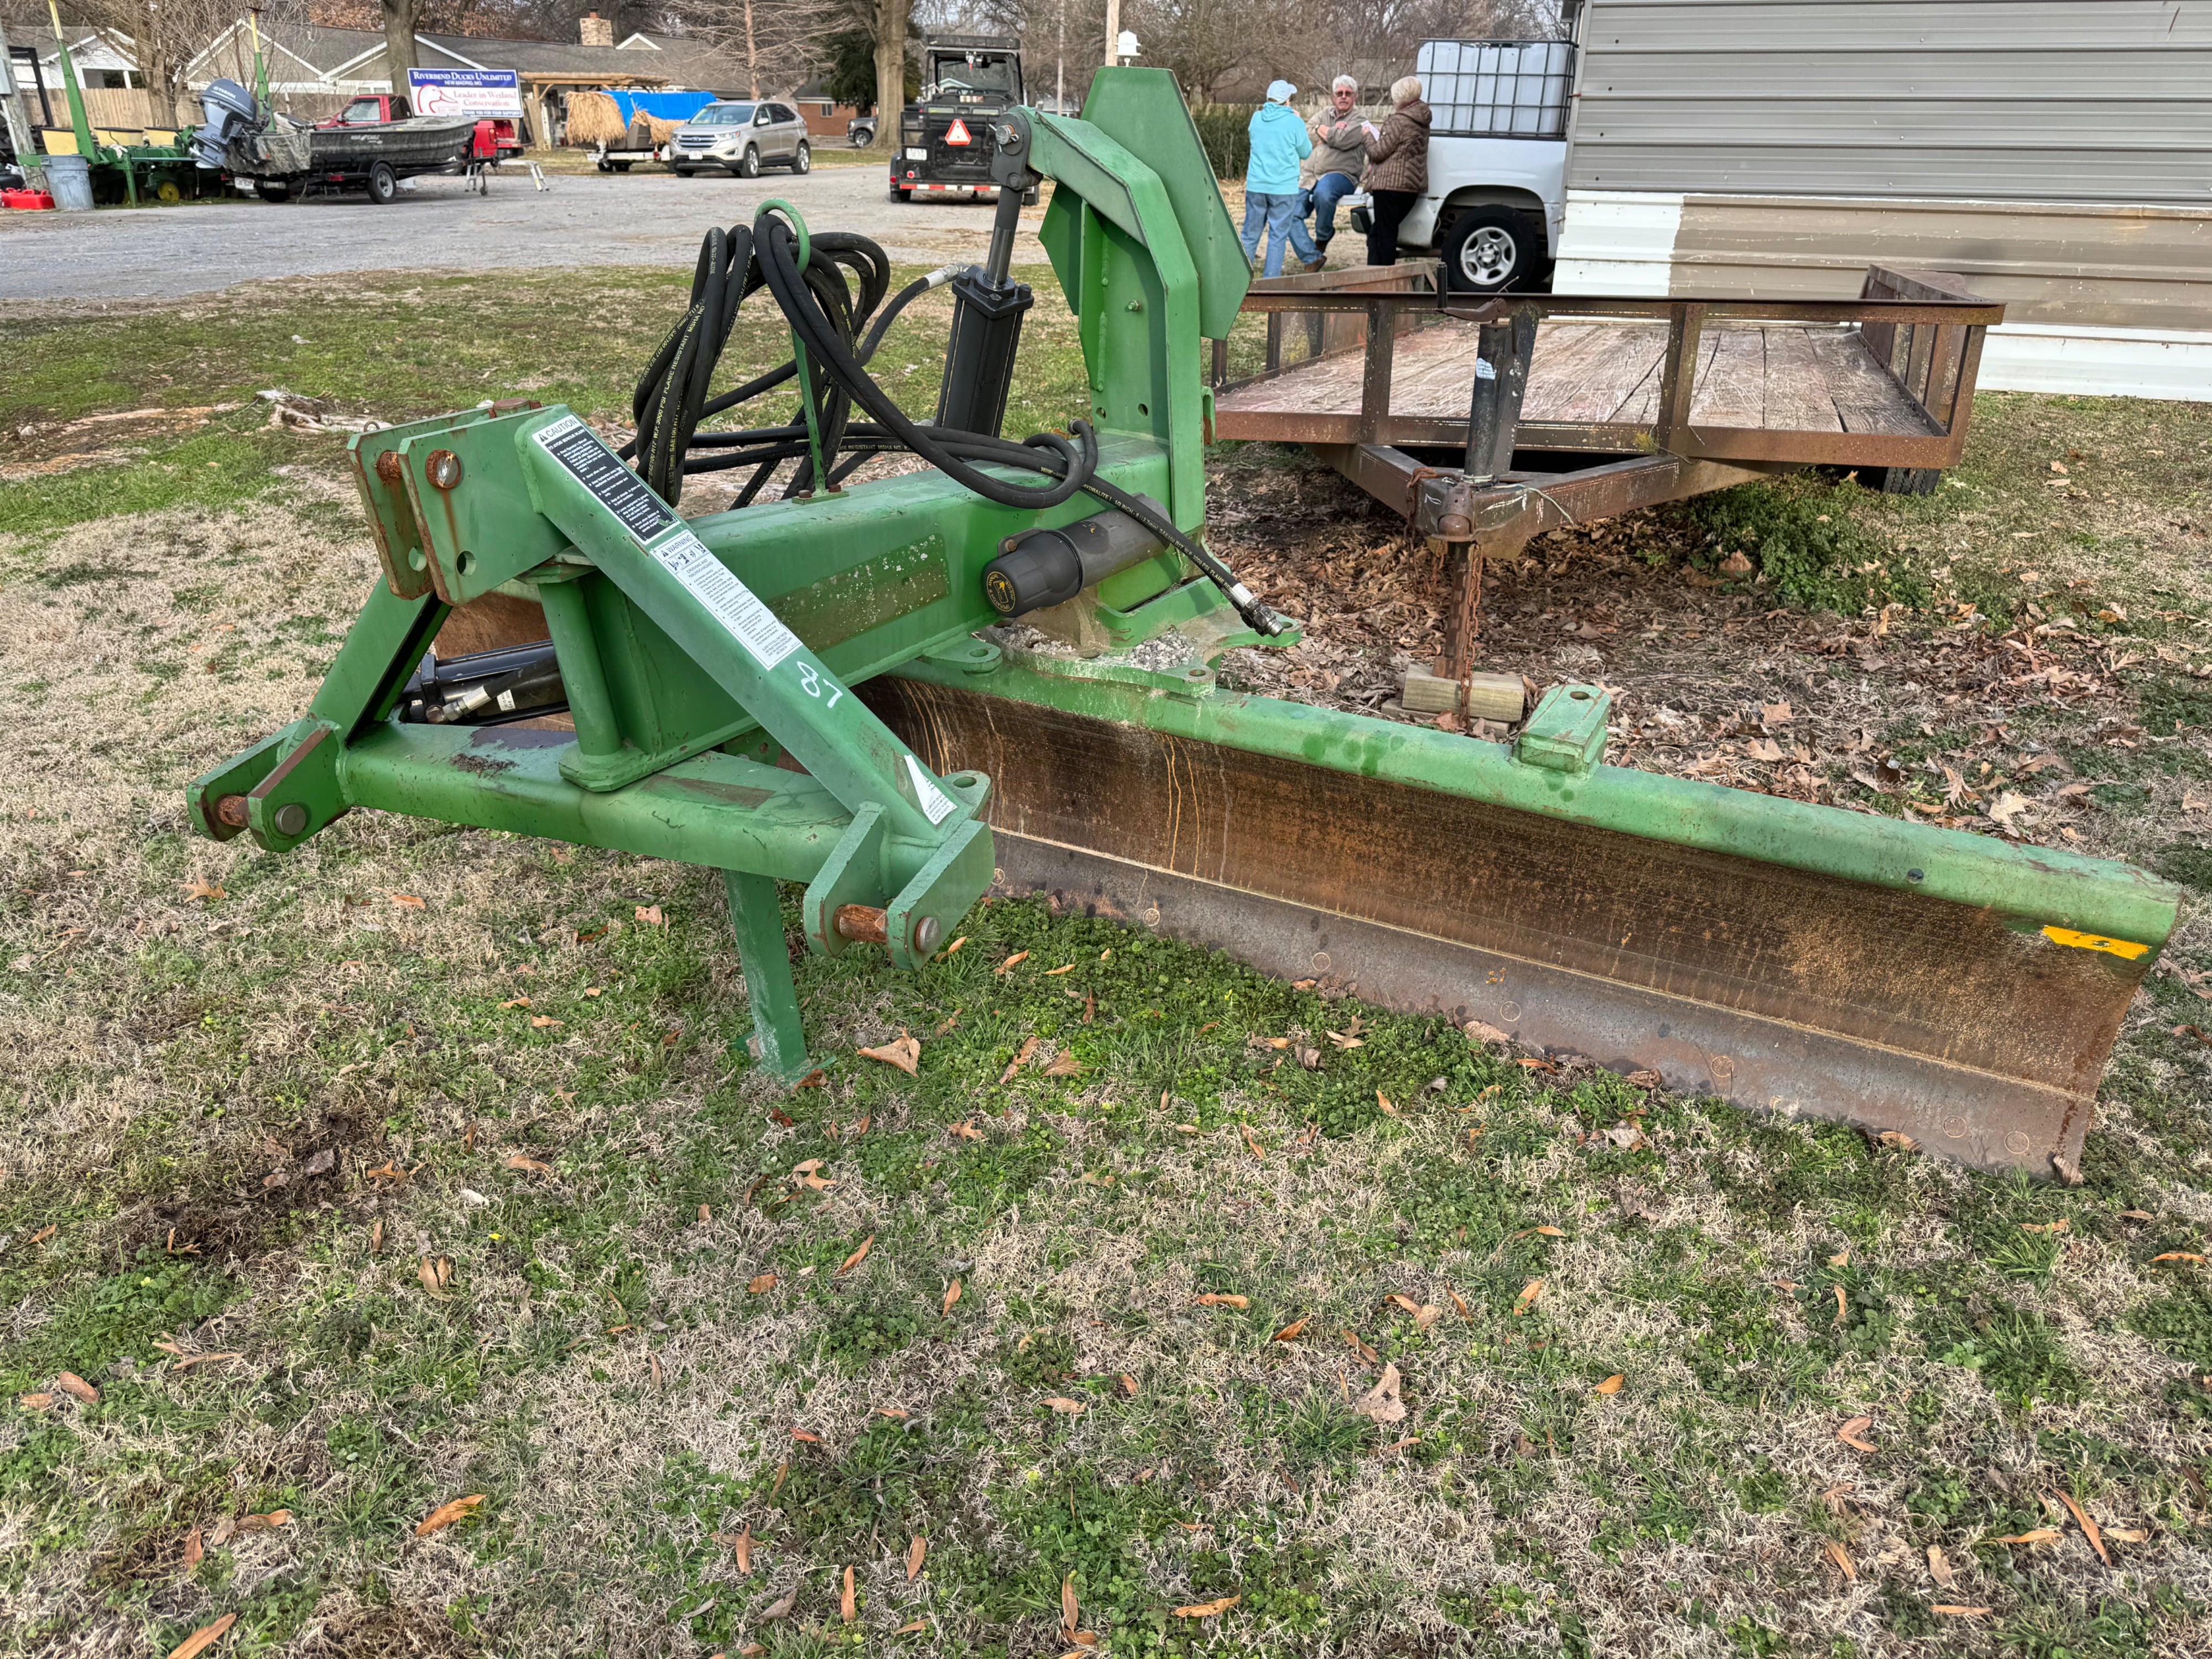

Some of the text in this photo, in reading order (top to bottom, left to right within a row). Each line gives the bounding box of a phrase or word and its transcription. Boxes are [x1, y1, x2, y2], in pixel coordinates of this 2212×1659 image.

[413, 72, 450, 80] RIVERBEND
[218, 88, 236, 99] YAMAHA
[664, 371, 674, 394] FLAME
[672, 336, 688, 369] RESISTANT
[688, 316, 700, 332] MSHA
[546, 419, 577, 437] CAUTION
[666, 535, 693, 553] WARNING
[1122, 504, 1133, 513] INCH
[1160, 529, 1175, 543] SAE100
[1210, 570, 1224, 582] FLAME
[988, 573, 999, 586] MANUAL
[797, 661, 843, 708] 87
